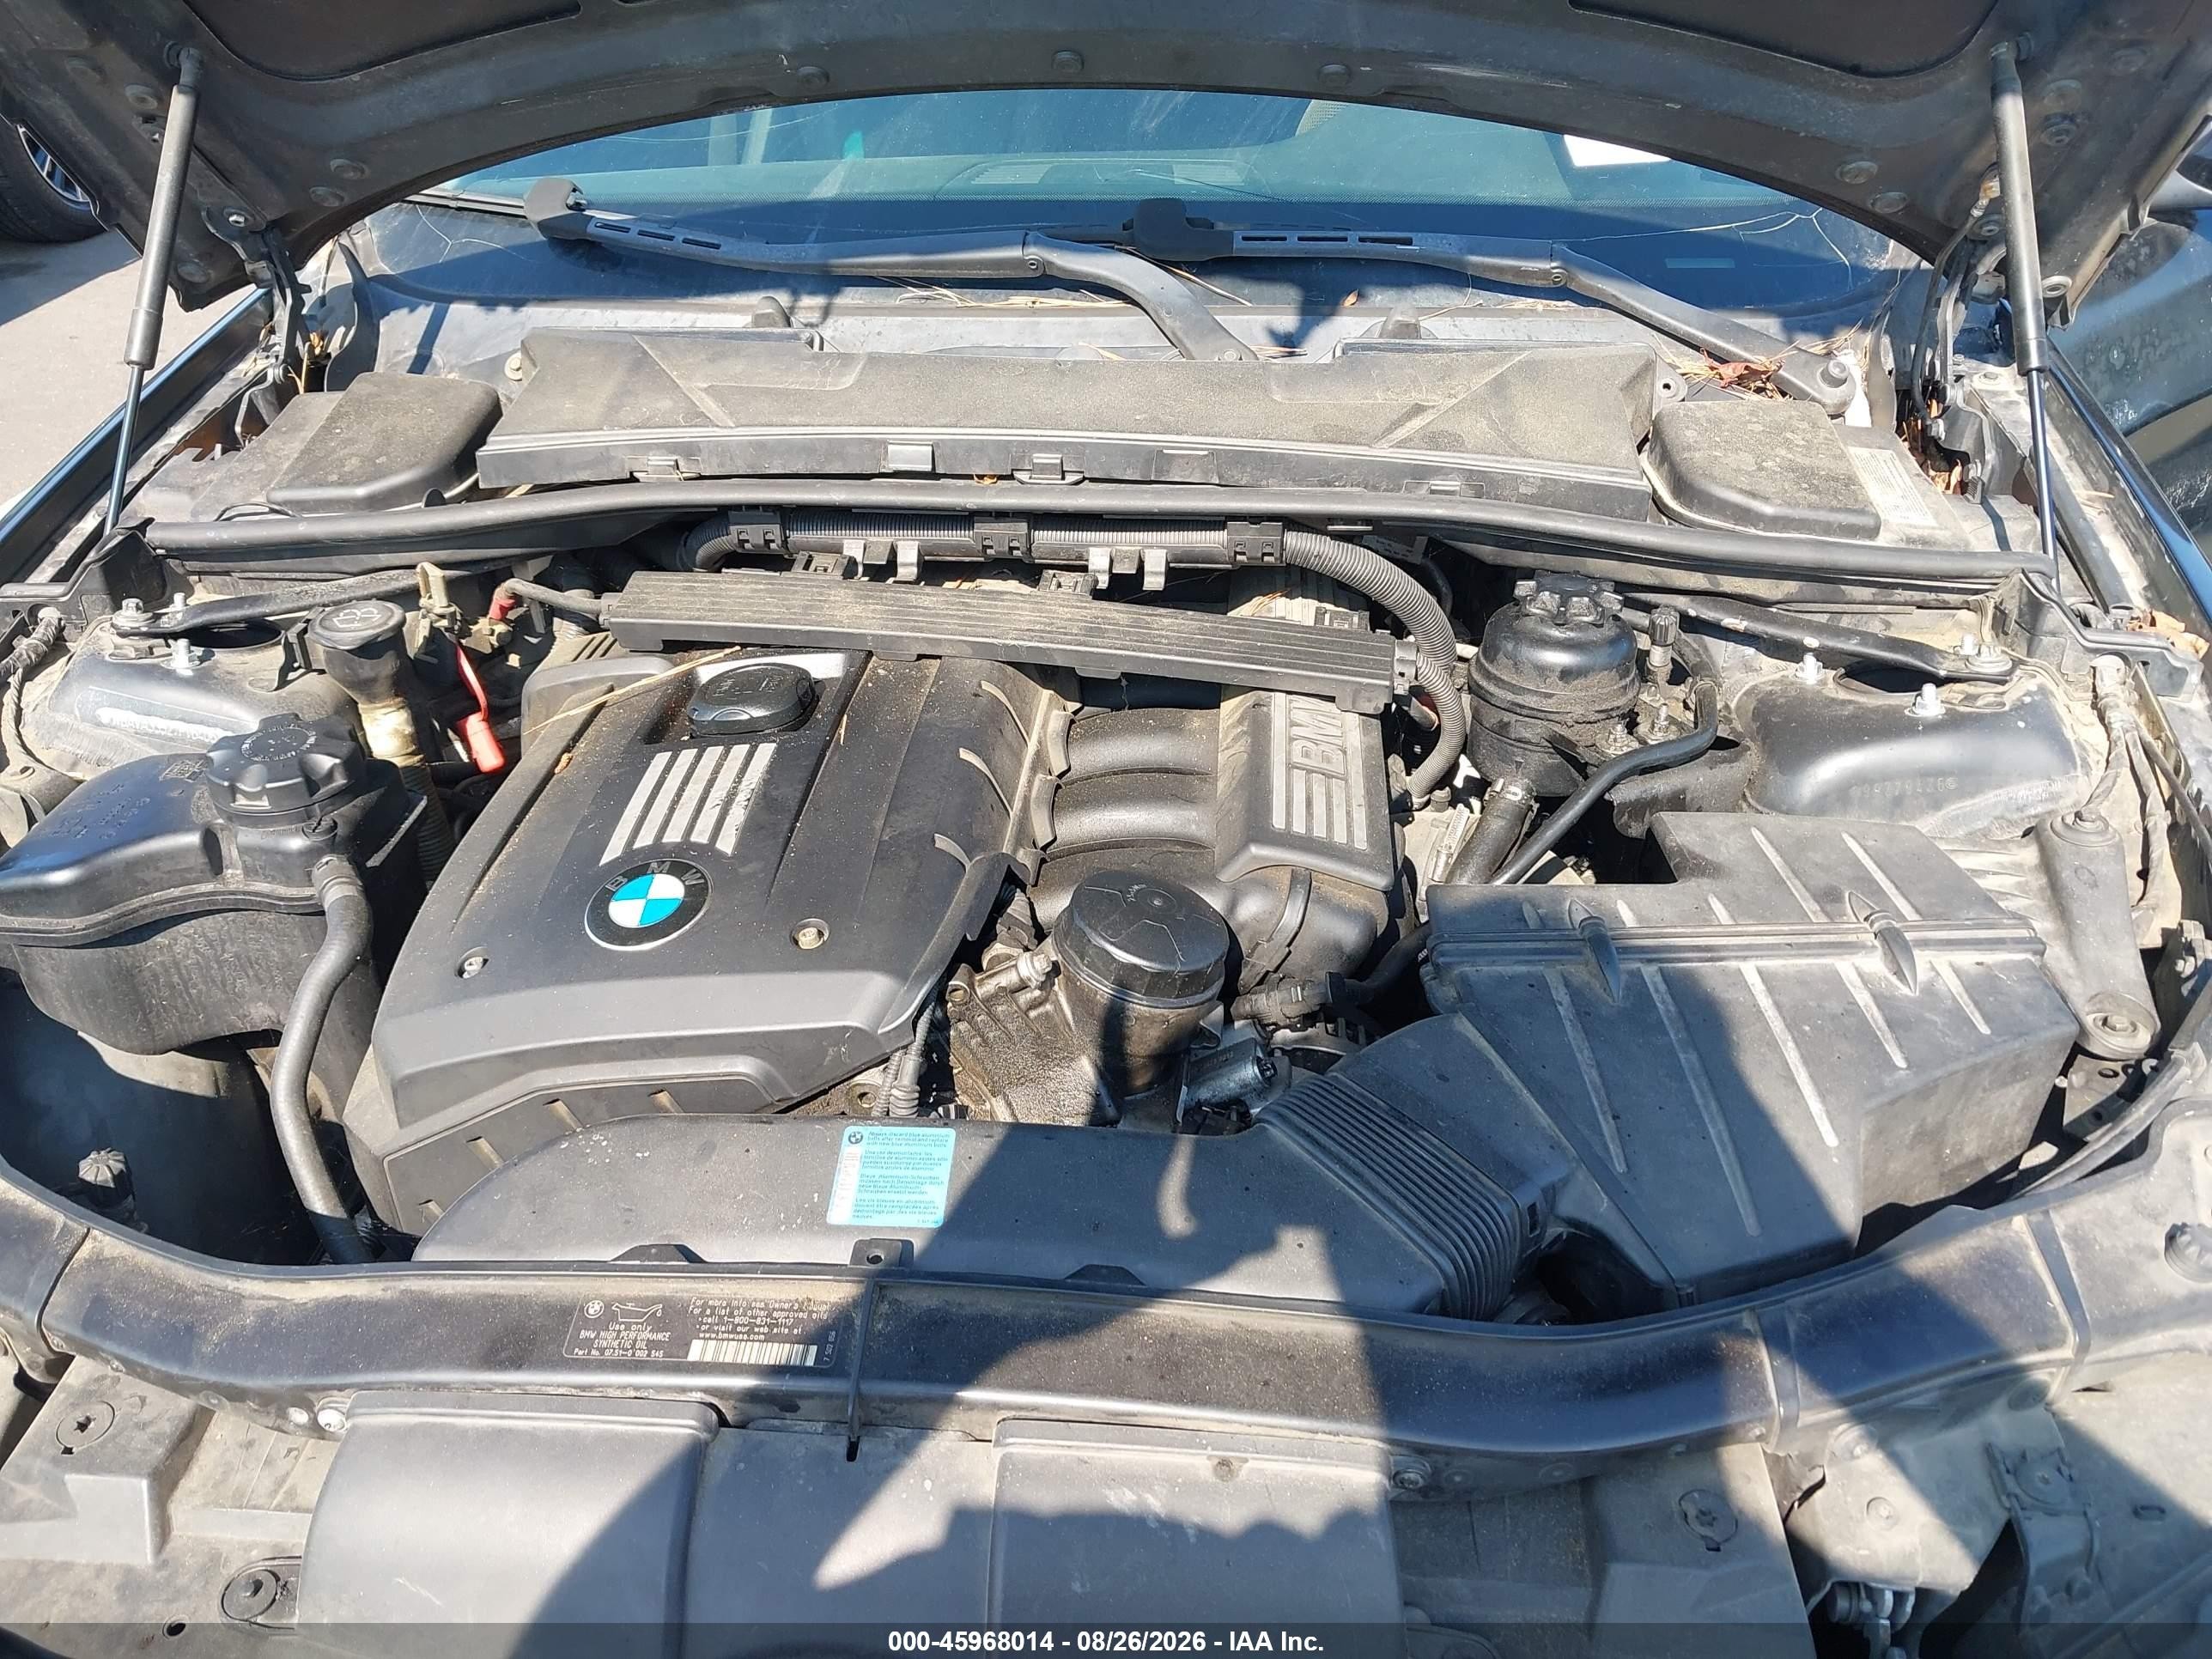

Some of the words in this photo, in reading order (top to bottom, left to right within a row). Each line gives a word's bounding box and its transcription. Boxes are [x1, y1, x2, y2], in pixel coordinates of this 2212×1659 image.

[605, 861, 705, 891] BMW
[690, 1297, 704, 1305] For
[688, 1305, 702, 1314] For
[715, 1306, 729, 1315] list
[734, 1307, 743, 1316] of
[747, 1308, 768, 1316] other
[773, 1310, 807, 1319] approved
[724, 1316, 793, 1326] 1-800-831-1117
[609, 1322, 625, 1331] Use
[631, 1322, 653, 1333] only
[773, 1325, 788, 1334] site
[580, 1329, 598, 1339] BMW
[599, 1330, 617, 1340] HIGH
[619, 1331, 672, 1341] PERFORMANCE
[699, 1332, 764, 1340] www.bmwusa.com
[592, 1339, 633, 1348] SYNTHETIC
[635, 1340, 647, 1349] OIL
